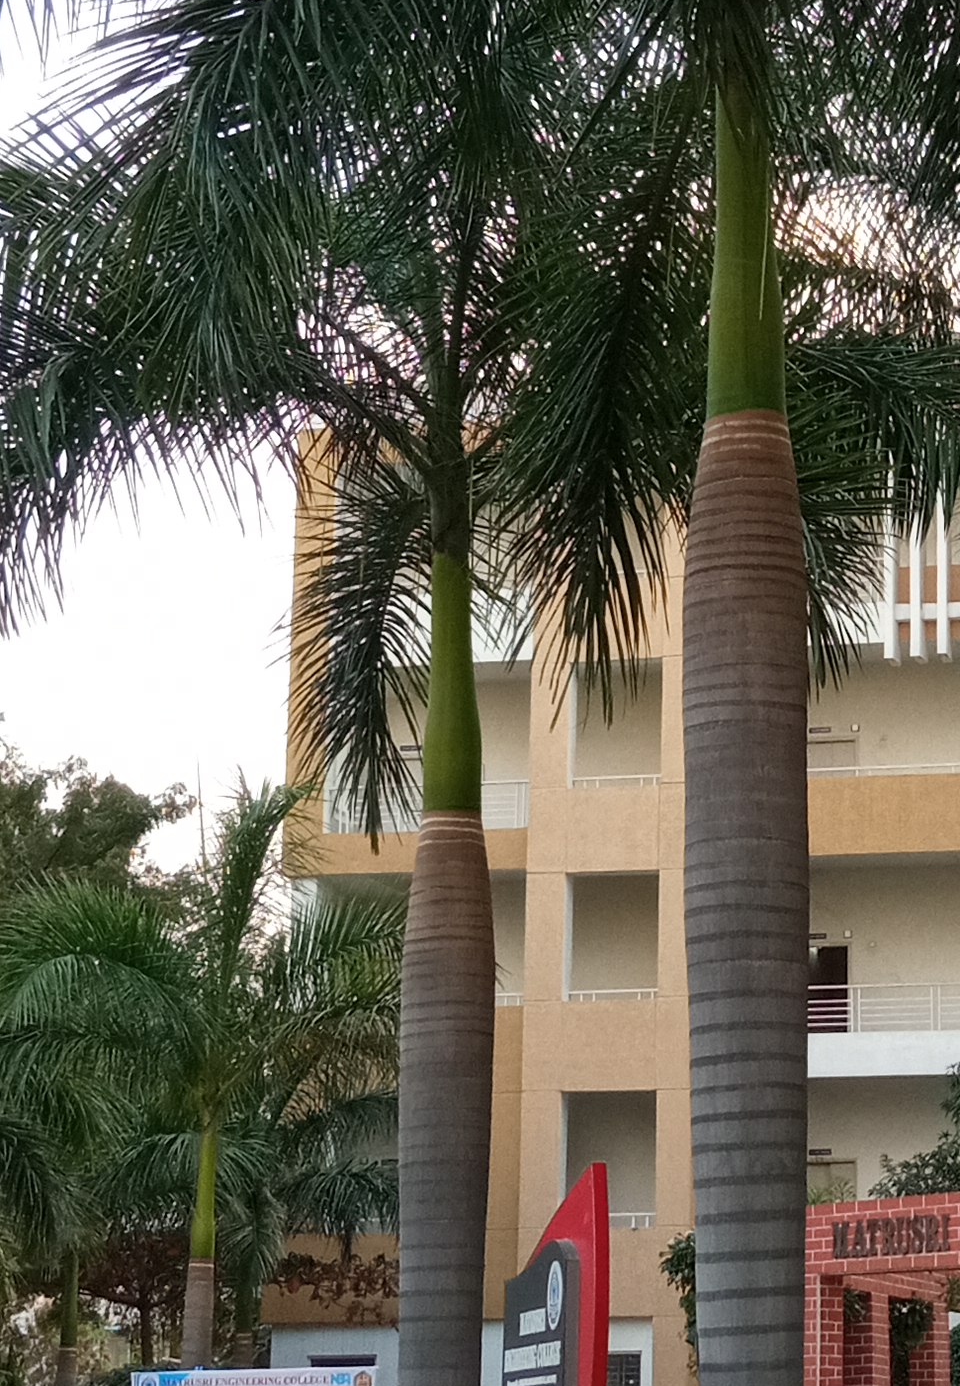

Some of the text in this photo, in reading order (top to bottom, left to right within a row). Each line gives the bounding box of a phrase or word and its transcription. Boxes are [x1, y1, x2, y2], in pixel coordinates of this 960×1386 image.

[832, 1214, 951, 1259] MATRUSRI
[163, 1374, 329, 1386] MATRUSRI ENGINEERING COLLEGE
